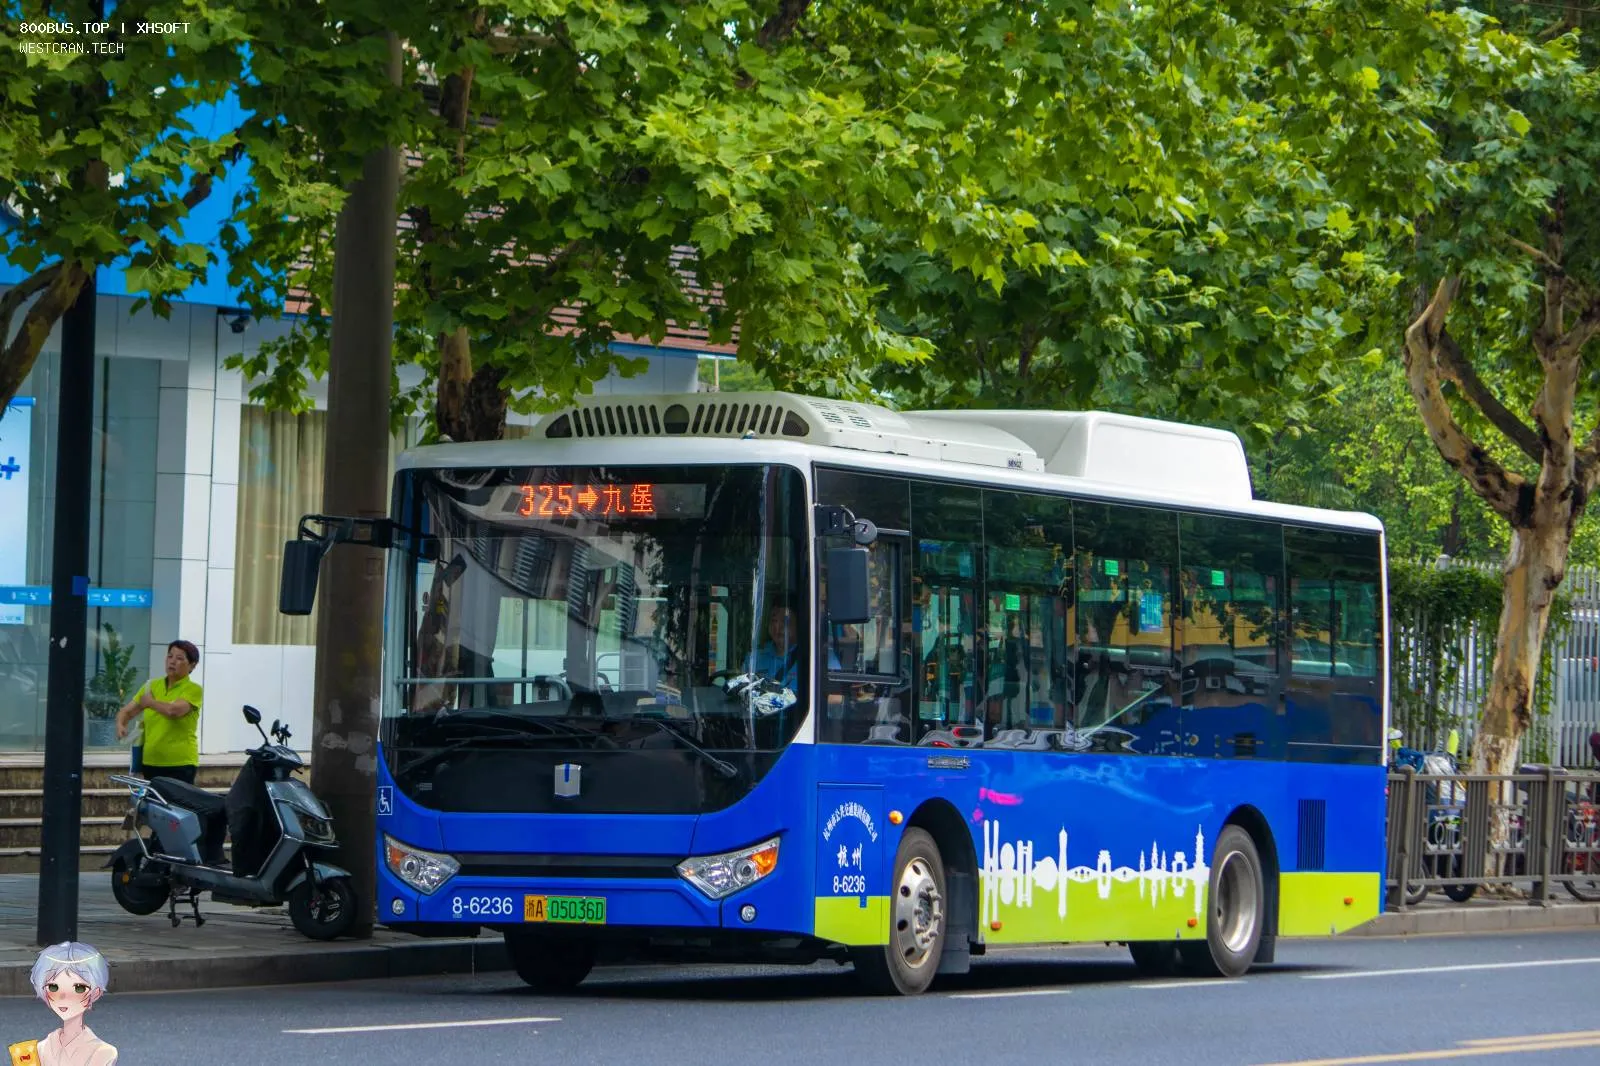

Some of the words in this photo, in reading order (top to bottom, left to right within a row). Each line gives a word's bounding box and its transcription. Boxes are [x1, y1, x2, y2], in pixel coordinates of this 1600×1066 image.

[520, 484, 574, 516] 325
[602, 484, 654, 514] 九堡
[836, 842, 863, 871] 杭州
[833, 875, 866, 893] 8-6236
[452, 896, 513, 915] 8-6236
